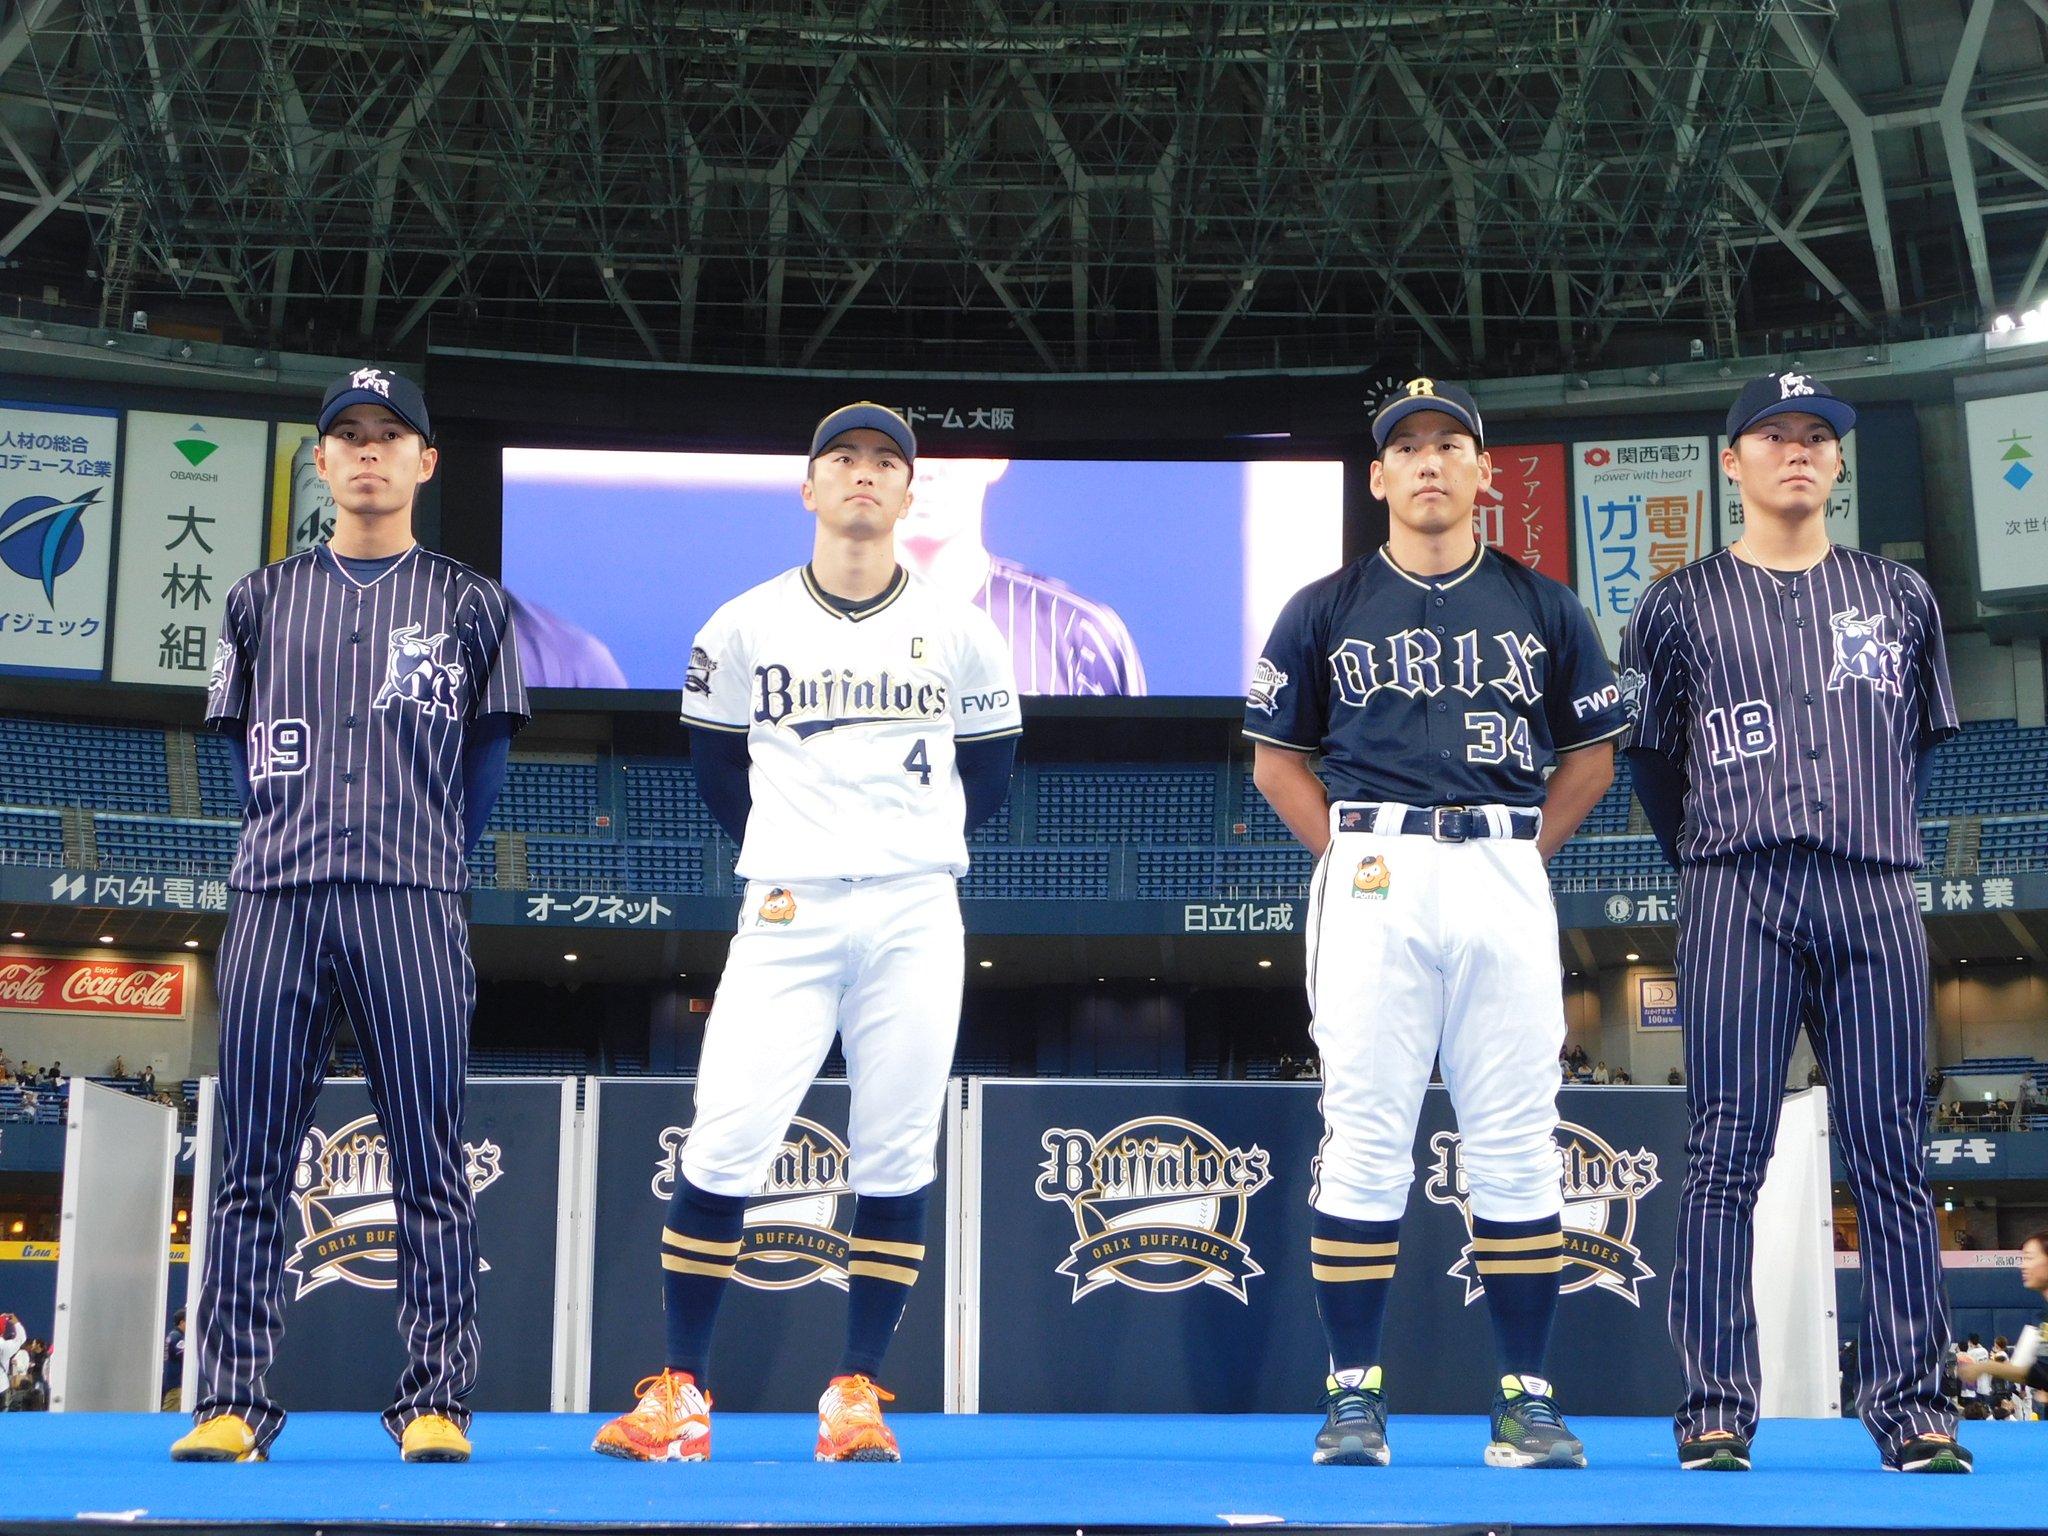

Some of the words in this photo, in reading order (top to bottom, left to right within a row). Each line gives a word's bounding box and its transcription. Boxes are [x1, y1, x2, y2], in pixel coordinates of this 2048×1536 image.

[0, 430, 89, 454] 人材の総合
[1617, 444, 1699, 464] 関西電力
[170, 471, 218, 483] OBAYASHI
[1594, 471, 1630, 484] power
[1633, 469, 1658, 480] with
[1660, 468, 1692, 479] heart
[158, 505, 216, 671] 大林組
[910, 637, 923, 659] C
[1328, 628, 1546, 707] ORIX
[755, 664, 948, 724] Buffaloes
[960, 690, 1010, 714] FWD
[1573, 684, 1619, 718] FWD
[1465, 712, 1533, 772] 34
[1705, 699, 1777, 765] 18
[250, 718, 311, 781] 19
[902, 738, 932, 787] 4
[94, 875, 228, 910] 内外電機
[526, 893, 672, 925] オークネット
[1184, 903, 1294, 931] 日立化成
[62, 967, 180, 1006] Coca-Cola
[94, 966, 118, 975] Enjoy!
[1035, 1128, 1275, 1212] Buffaloes
[318, 1234, 357, 1256] ORIX
[756, 1232, 845, 1258] BUFFALOES
[1093, 1237, 1131, 1259] ORIX
[1140, 1234, 1230, 1261] BUFFALOES
